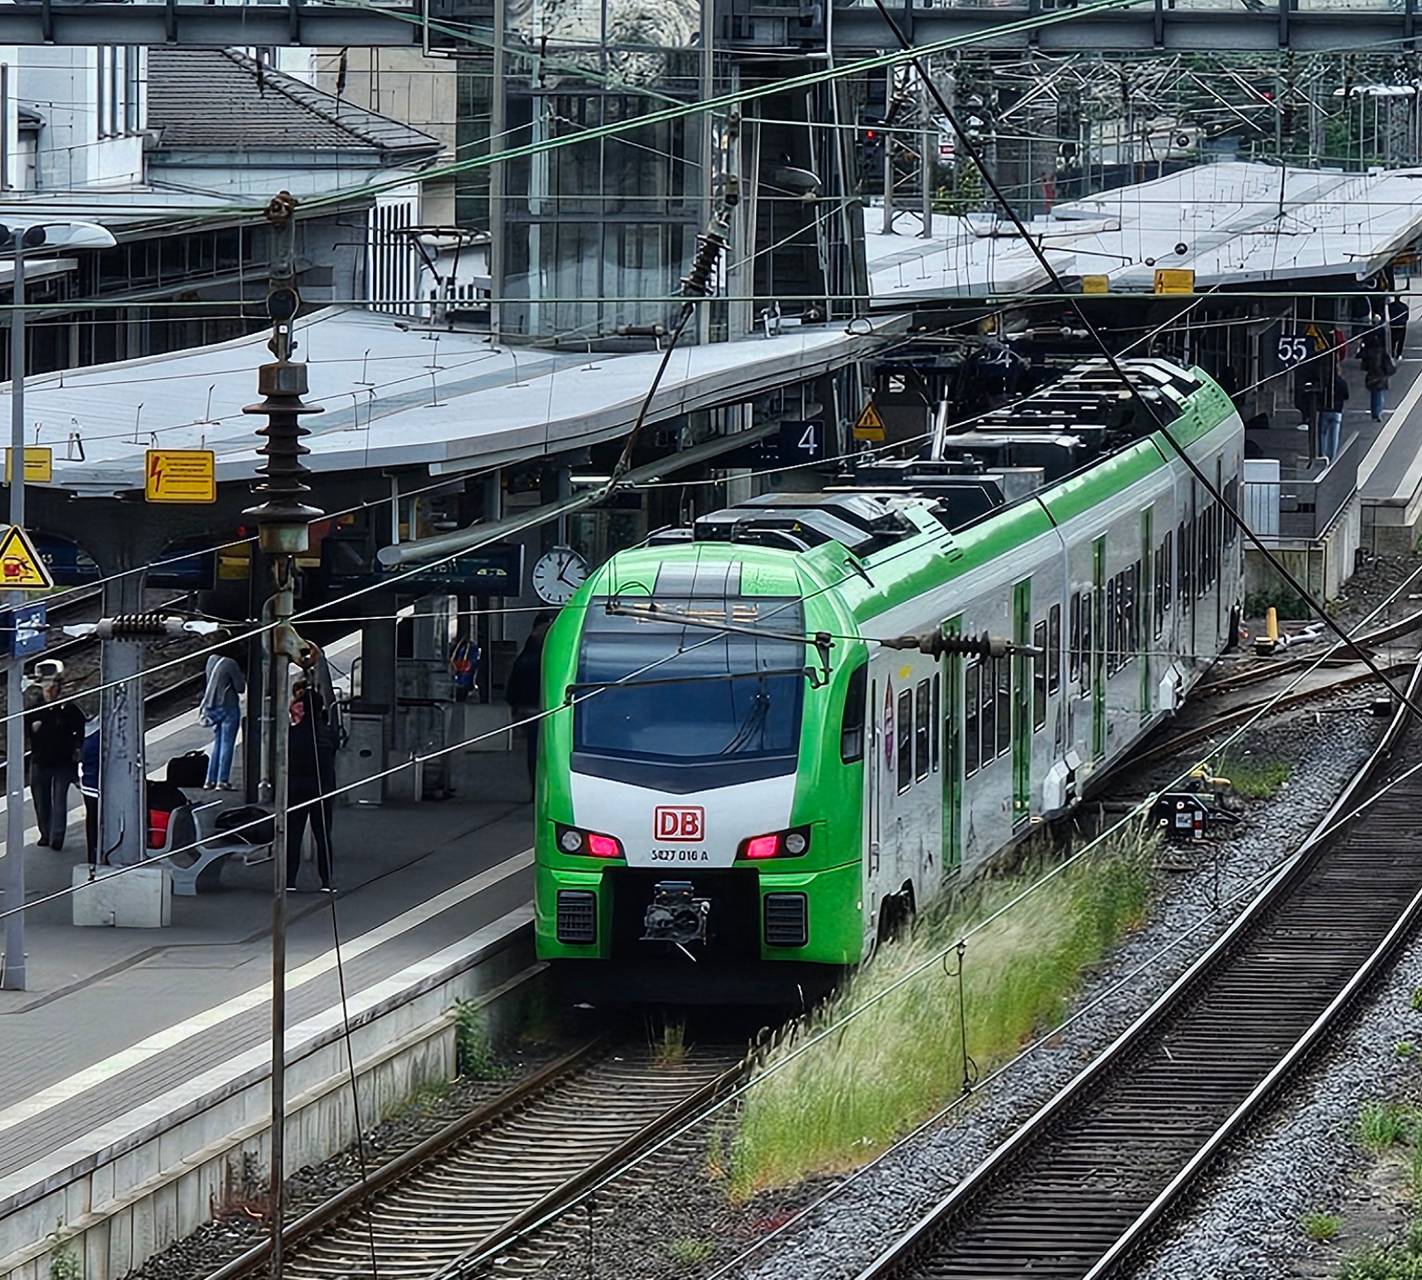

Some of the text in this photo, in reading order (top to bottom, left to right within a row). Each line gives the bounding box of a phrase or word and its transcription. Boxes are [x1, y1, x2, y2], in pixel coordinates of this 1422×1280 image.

[1278, 337, 1307, 362] 55
[797, 424, 818, 455] 4
[659, 809, 701, 838] DB
[700, 850, 709, 861] A
